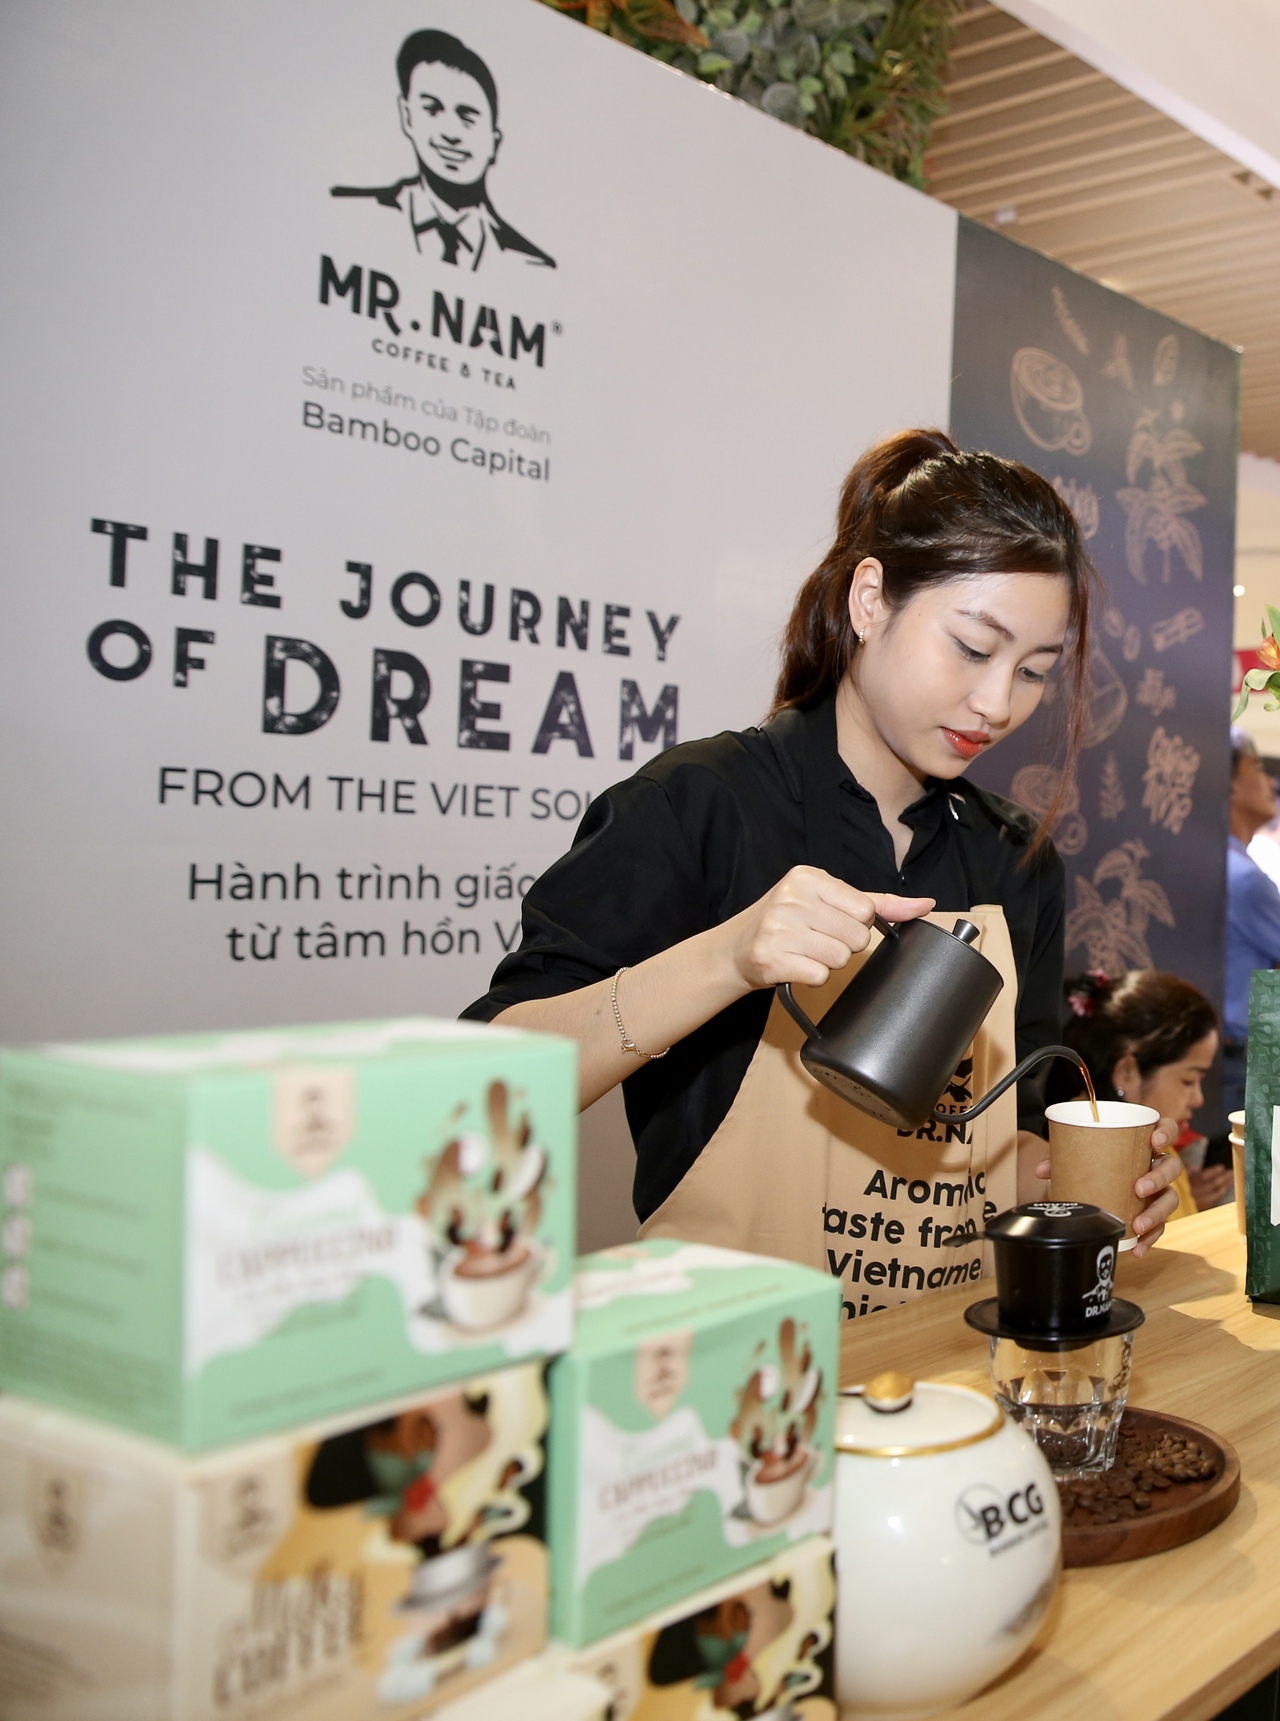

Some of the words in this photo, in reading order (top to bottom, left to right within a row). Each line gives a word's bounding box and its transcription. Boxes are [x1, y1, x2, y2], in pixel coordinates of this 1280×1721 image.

[319, 253, 547, 369] MR.NAM
[371, 338, 449, 372] COFFEE
[481, 367, 518, 390] TEA
[301, 365, 345, 393] Sản
[351, 378, 417, 411] phẩm
[420, 396, 459, 422] của
[463, 407, 499, 434] Tập
[502, 418, 551, 444] đoàn
[302, 401, 442, 456] Bamboo
[450, 437, 551, 482] Capital
[91, 517, 282, 609] THE
[340, 560, 681, 662] JOURNEY
[87, 619, 216, 688] OF
[262, 634, 679, 761] DREAM
[158, 767, 311, 810] FROM
[327, 776, 416, 815] THE
[430, 782, 520, 818] VIET
[188, 862, 321, 902] Hành
[336, 863, 440, 901] trình
[226, 924, 282, 961] từ
[295, 922, 387, 959] tâm
[402, 916, 480, 956] hồn
[981, 1482, 1043, 1539] BCG
